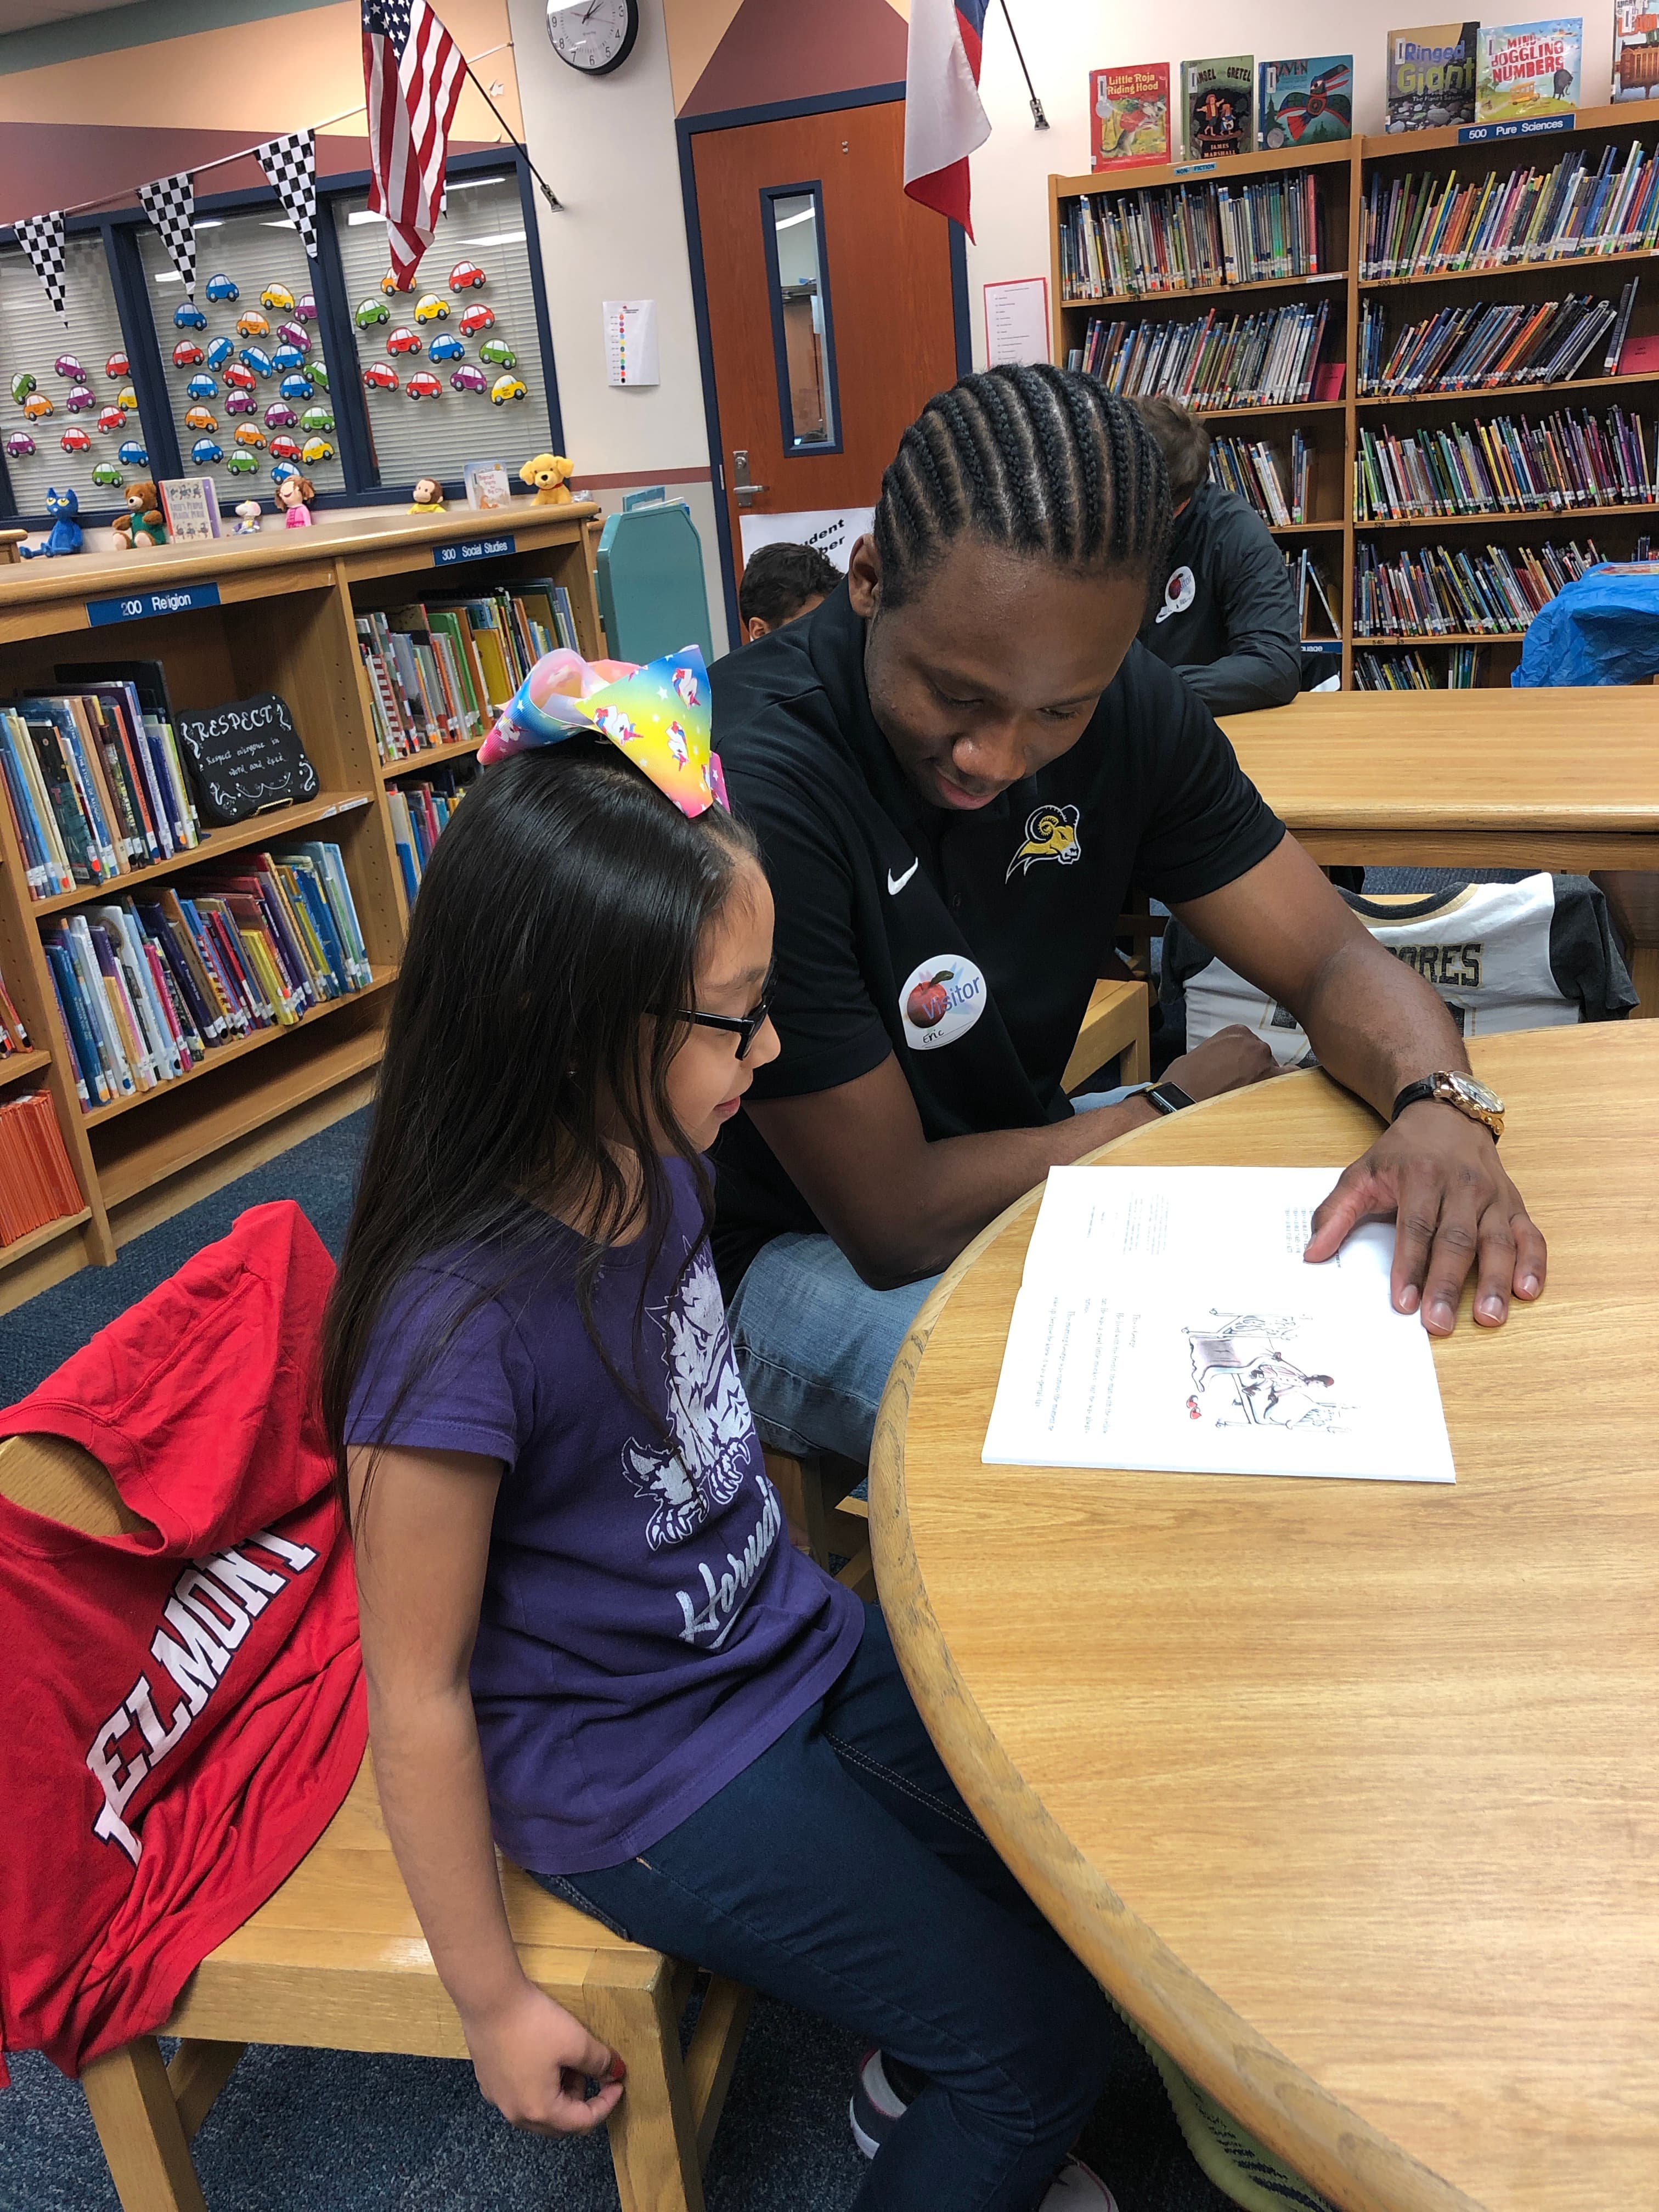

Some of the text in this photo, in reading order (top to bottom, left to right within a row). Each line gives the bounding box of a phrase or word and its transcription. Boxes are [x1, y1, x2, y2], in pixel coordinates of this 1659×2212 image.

[619, 5, 624, 17] 3
[552, 16, 557, 27] 9
[615, 29, 620, 38] 4
[559, 38, 565, 49] 8
[571, 51, 576, 63] 7
[606, 47, 611, 58] 5
[1406, 40, 1465, 63] Ringed
[589, 55, 595, 65] 6
[1227, 67, 1251, 82] GRETEL
[1492, 55, 1564, 82] NUMBERS
[1109, 73, 1154, 85] Little Roja
[1397, 57, 1475, 96] Giant
[1107, 81, 1159, 95] Riding Hood
[1469, 120, 1564, 139] 500 Pure Sciences
[1194, 163, 1215, 171] FICTION
[442, 541, 508, 561] 300 Social Studies
[121, 600, 142, 616] 200
[193, 705, 273, 741] RESPECT
[250, 760, 265, 771] and
[922, 977, 980, 1019] Visitor
[923, 1029, 944, 1043] Eric
